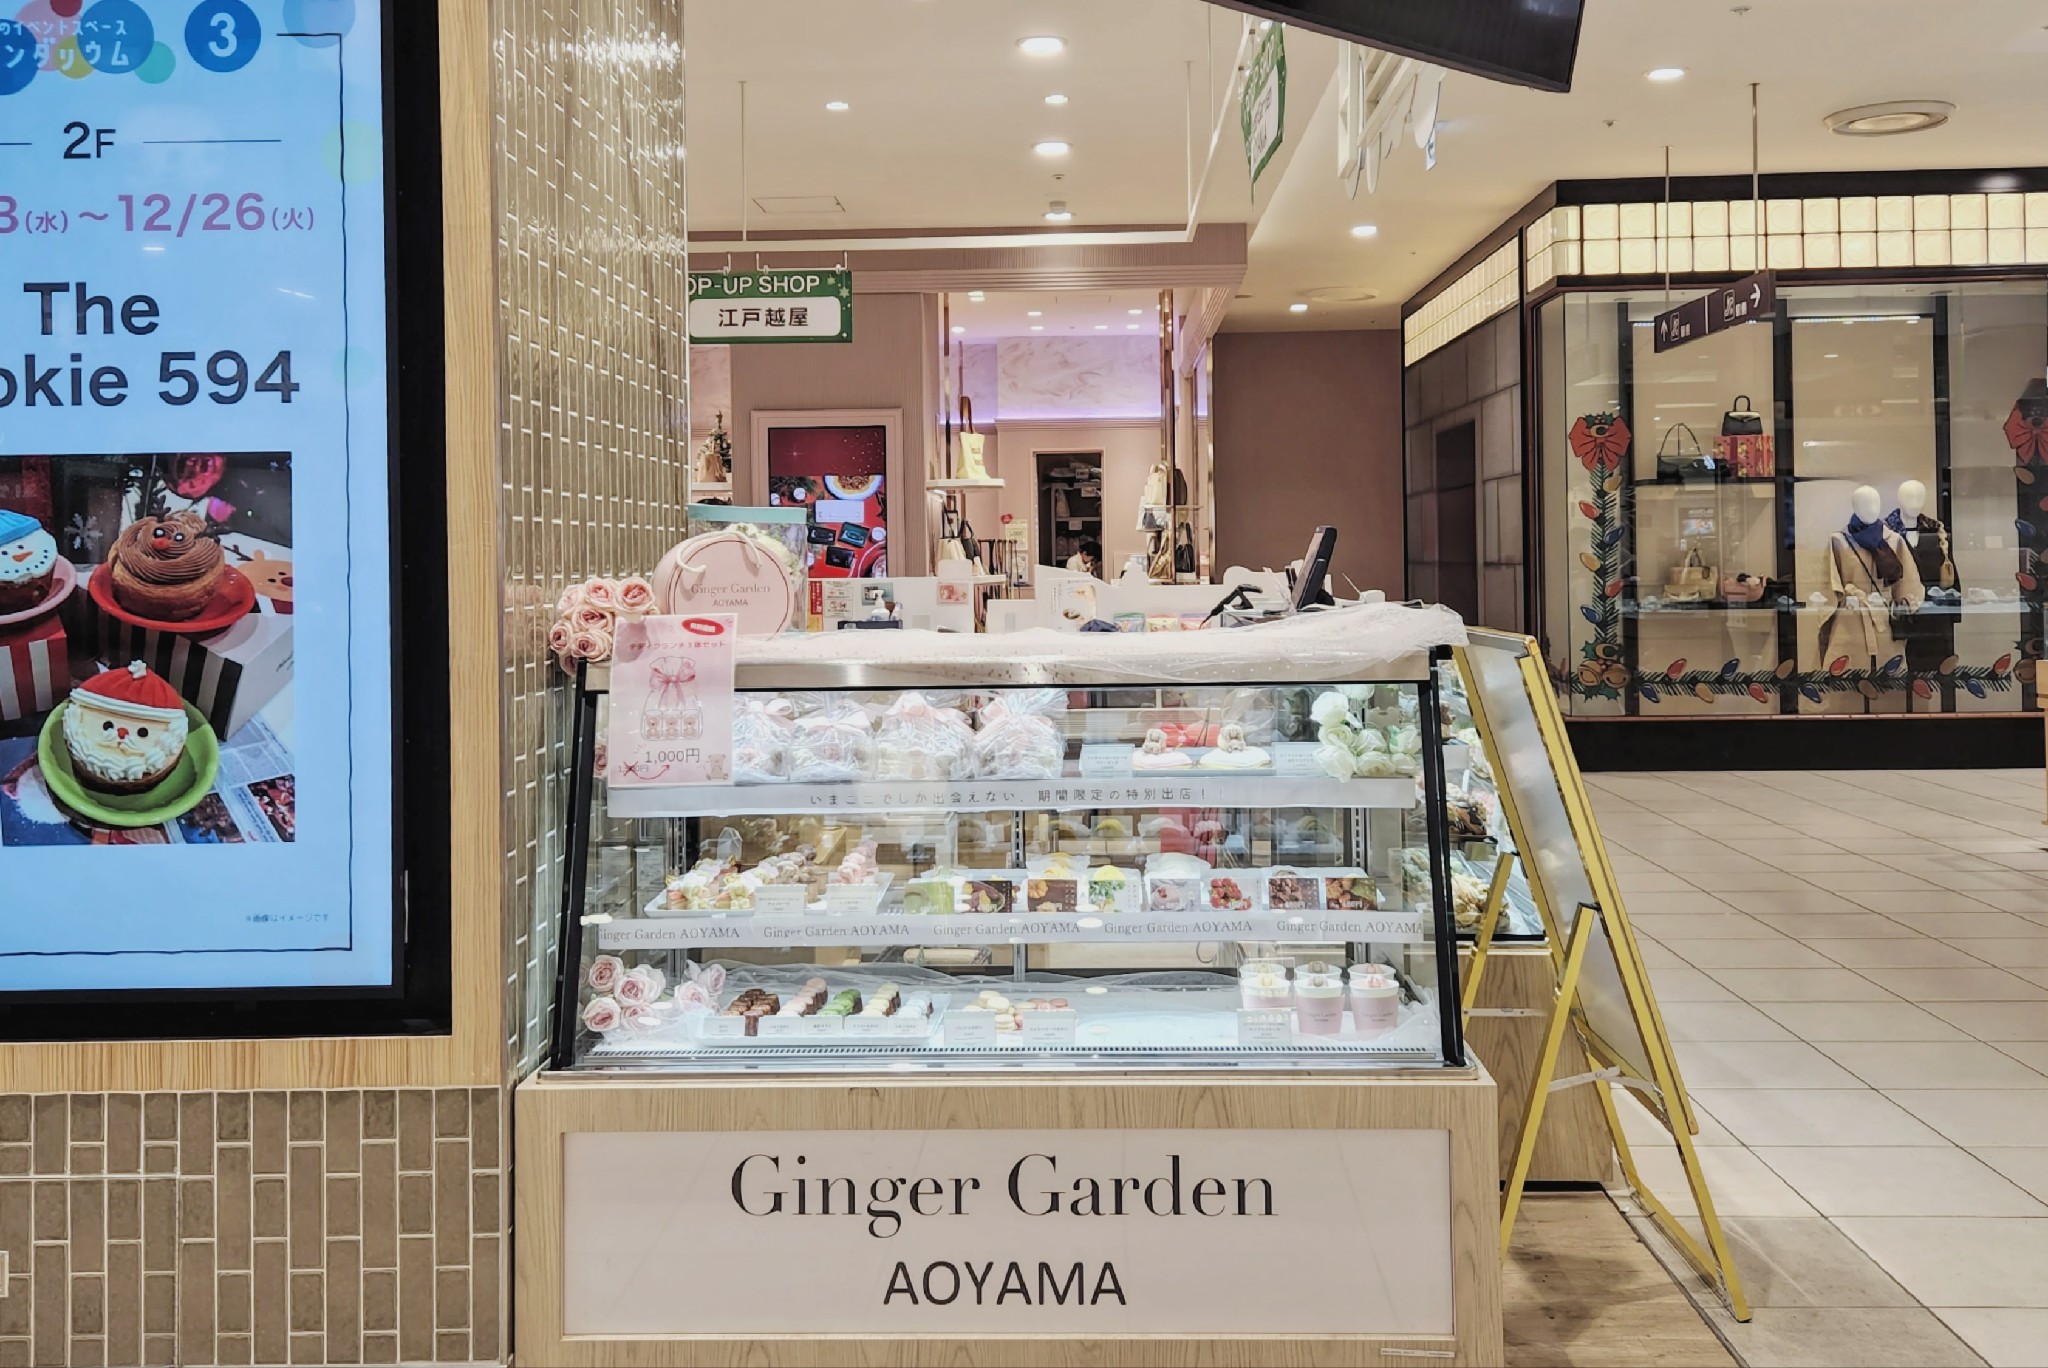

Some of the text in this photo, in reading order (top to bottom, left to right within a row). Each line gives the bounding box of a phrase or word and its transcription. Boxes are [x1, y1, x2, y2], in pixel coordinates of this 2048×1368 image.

[208, 12, 239, 57] 3
[63, 121, 117, 160] 2F
[758, 274, 820, 295] SHOP
[23, 281, 160, 336] The
[718, 307, 809, 328] 江戸越屋
[158, 349, 301, 405] 594
[690, 583, 771, 597] Ginger Garden
[712, 598, 749, 607] AOYAMA
[644, 747, 701, 765] 1,000円
[599, 927, 740, 943] inger Garden AOYAMA
[763, 924, 910, 939] Ginger Garden AOYAMA
[933, 922, 1081, 938] Ginger Garden AOYAMA
[1104, 920, 1253, 936] Ginger Garden AOYAMA
[1276, 920, 1423, 934] Ginger Garden AOYAMA
[731, 1153, 1279, 1238] Ginger Garden
[883, 1260, 1127, 1306] AOYAMA
